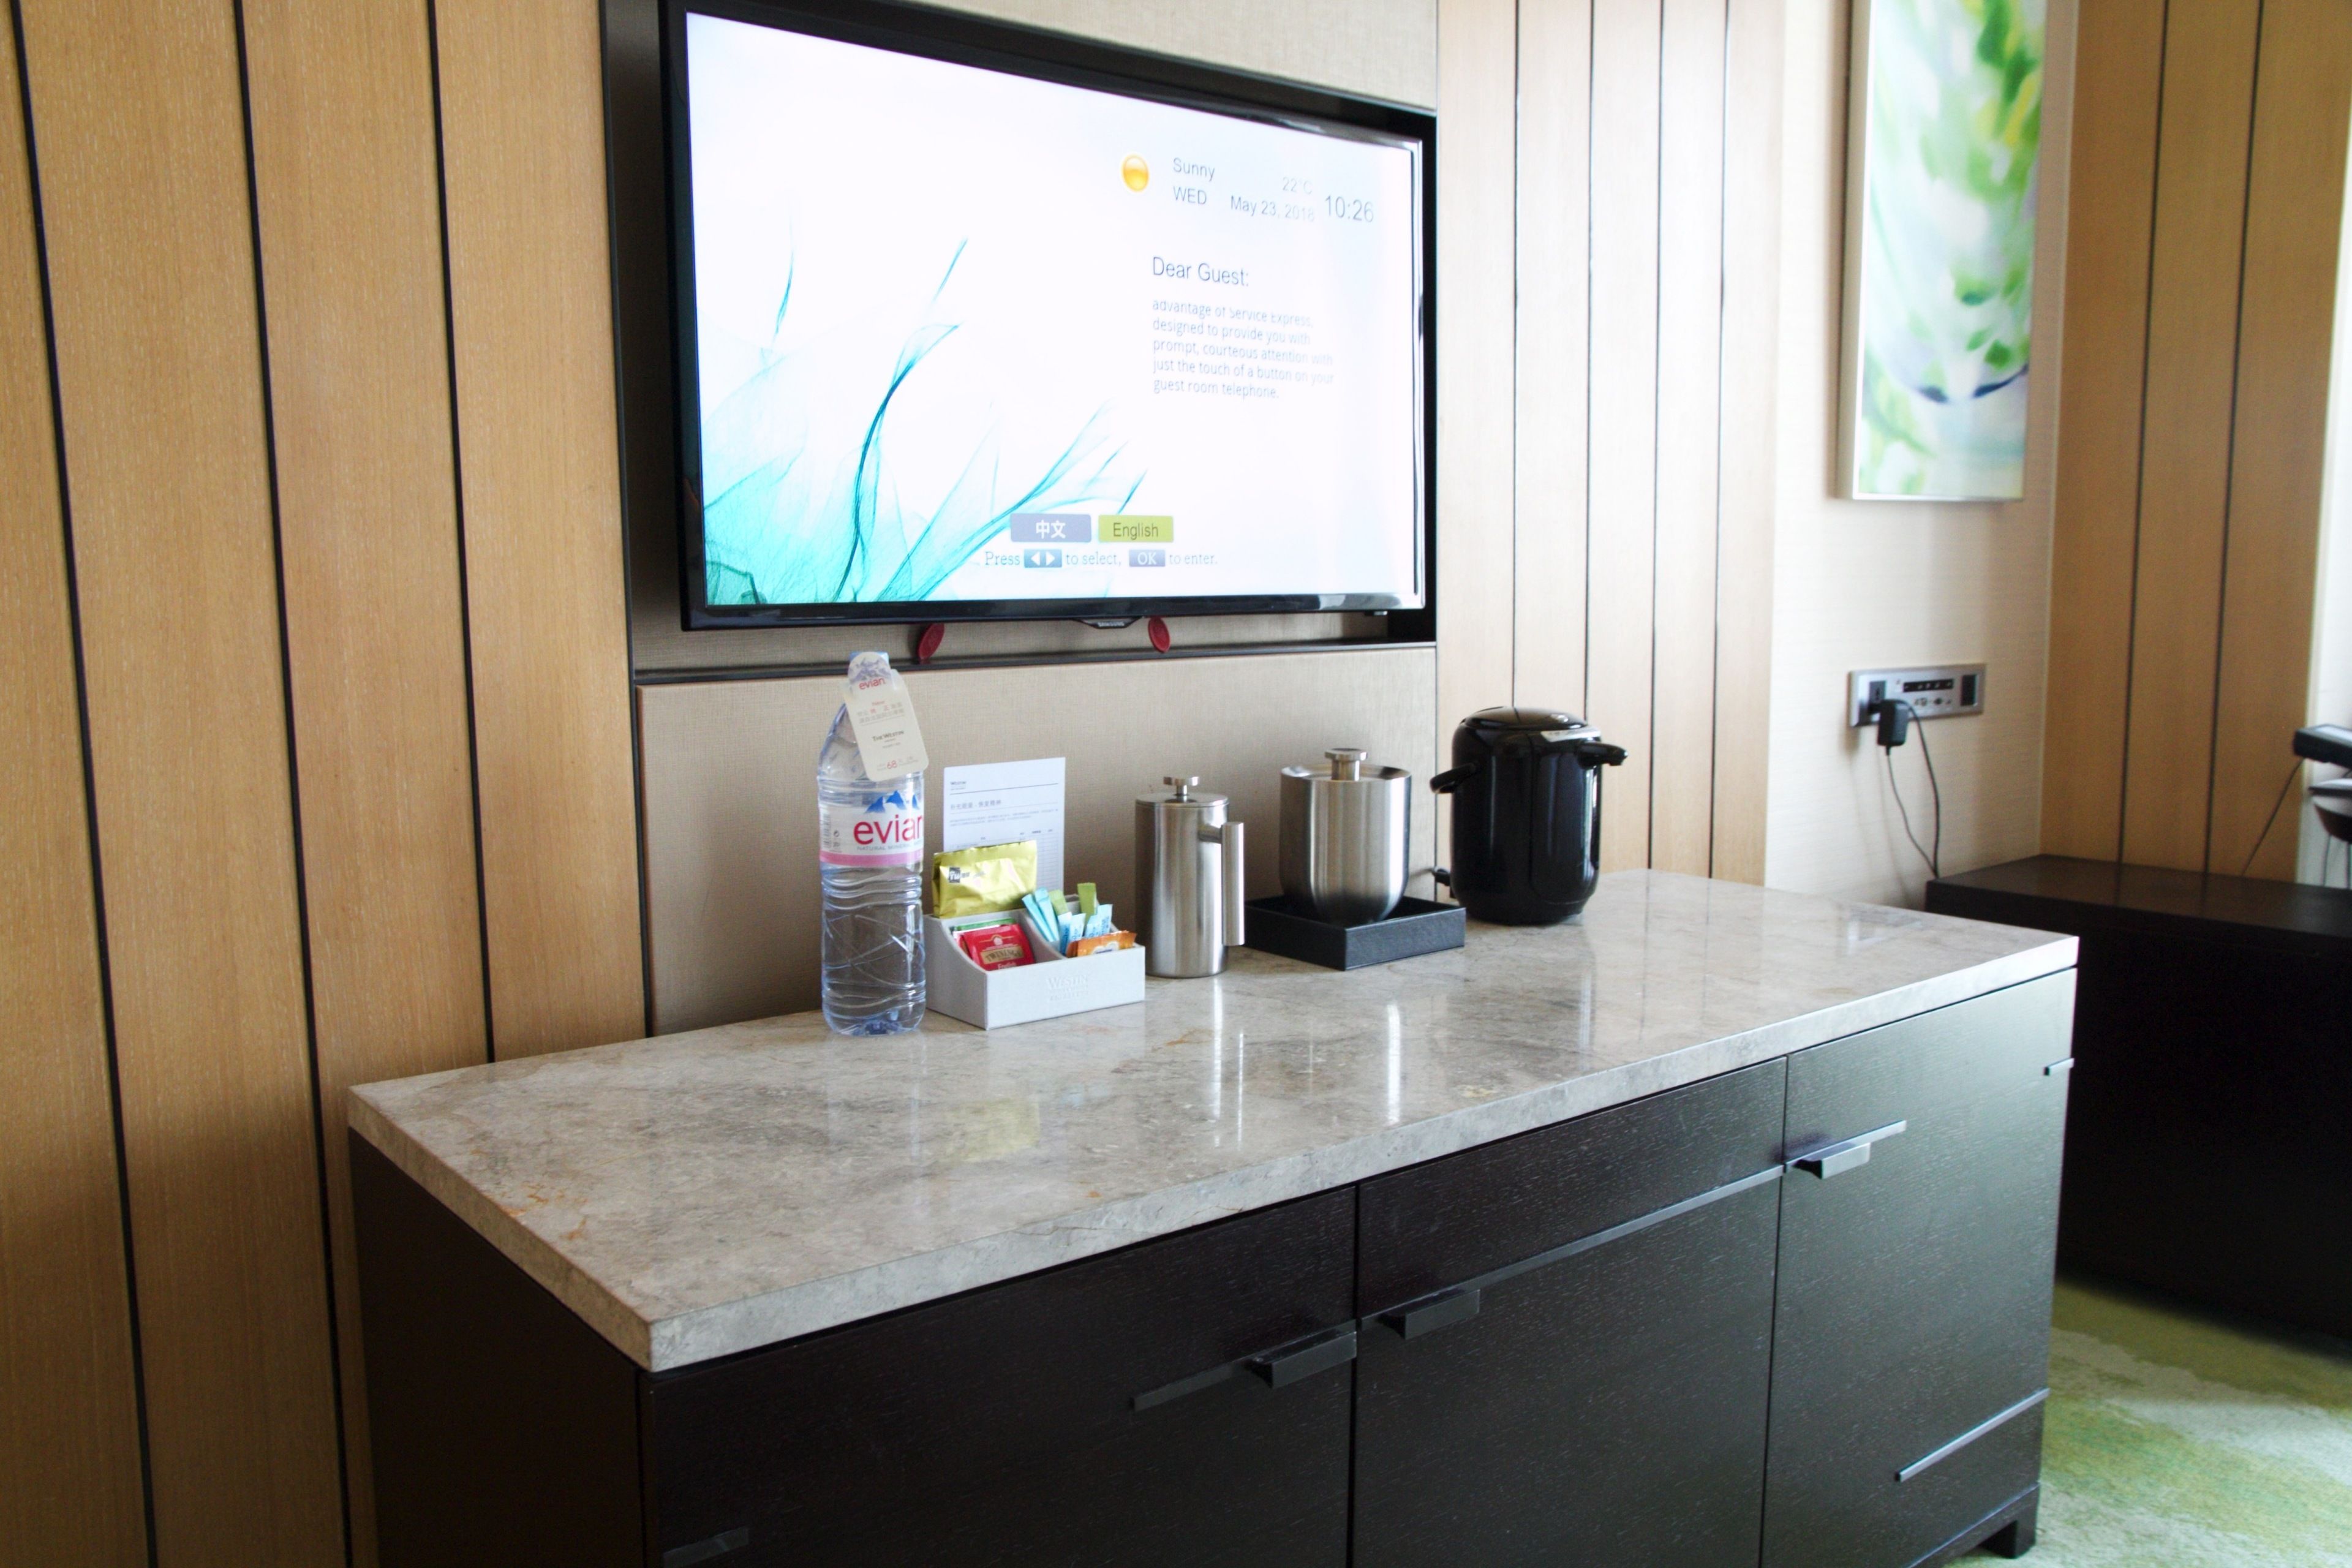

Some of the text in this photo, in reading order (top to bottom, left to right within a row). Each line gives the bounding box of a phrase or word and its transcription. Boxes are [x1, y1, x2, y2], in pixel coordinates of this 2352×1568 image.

[1173, 157, 1215, 182] Sunny
[1173, 186, 1314, 222] WED May 23, 2018
[1325, 195, 1374, 223] 10:26
[1152, 256, 1249, 288] Dear Guest:
[1152, 299, 1212, 319] advantage
[1215, 306, 1226, 317] of
[1230, 307, 1267, 323] Service
[1153, 318, 1311, 345] designed to provide you with
[1153, 339, 1333, 366] prompt, courteous attention with
[1152, 357, 1334, 386] just the touch of a button on your
[1153, 379, 1280, 401] guest room telephone.
[1035, 520, 1066, 539] 中文
[1114, 522, 1159, 540] English
[984, 552, 1218, 567] Press to select, OK to enter.
[859, 677, 886, 690] evian
[886, 760, 898, 769] 68
